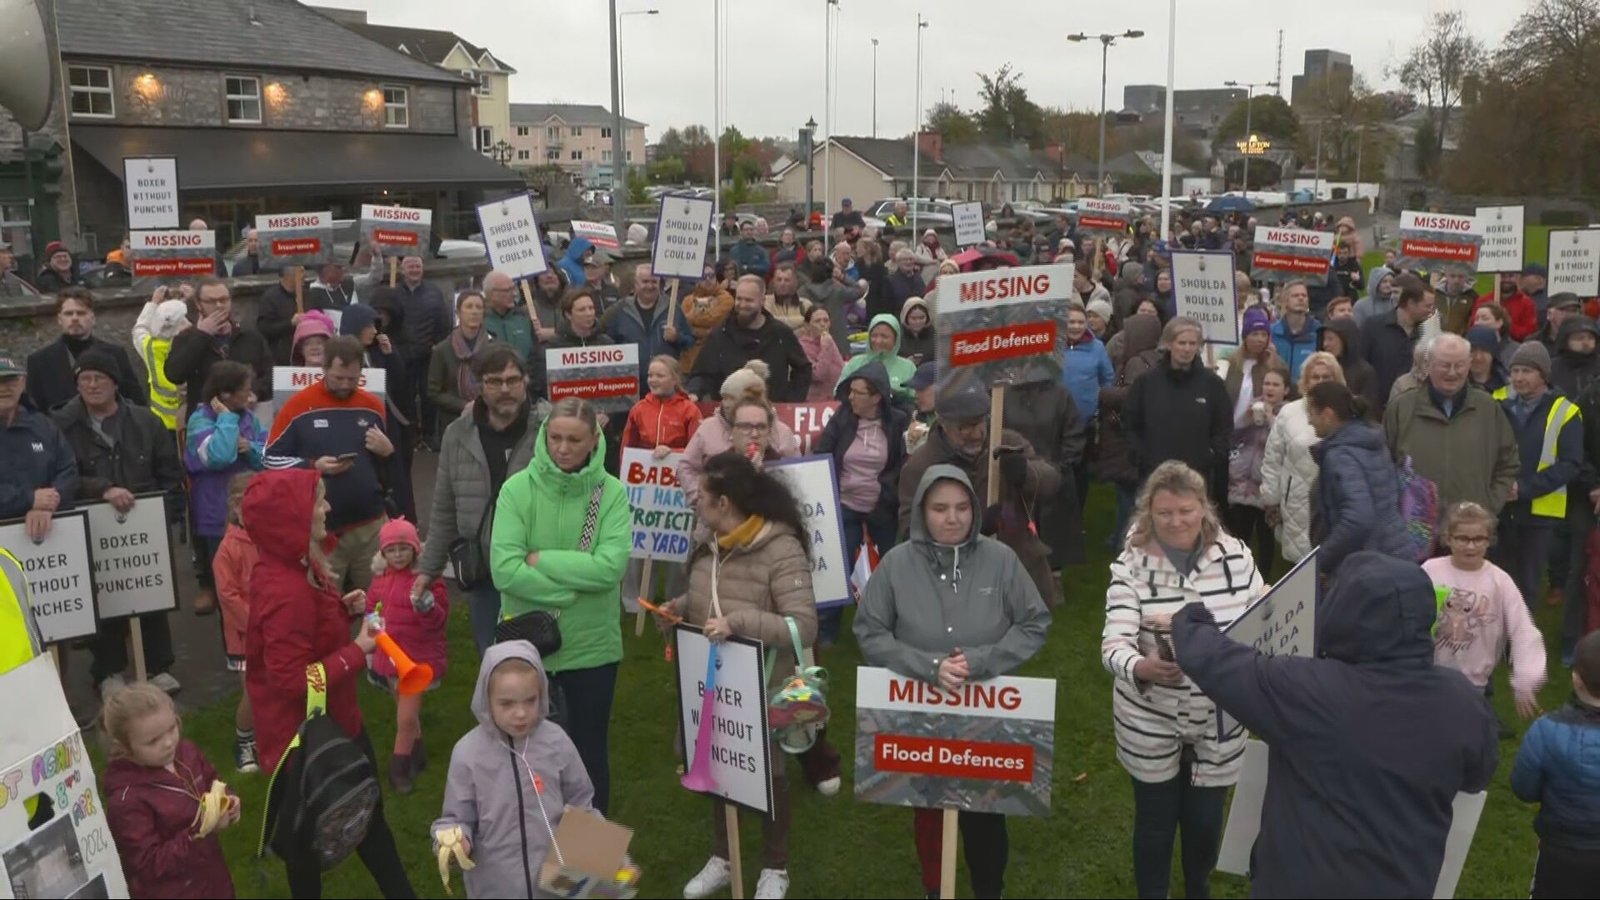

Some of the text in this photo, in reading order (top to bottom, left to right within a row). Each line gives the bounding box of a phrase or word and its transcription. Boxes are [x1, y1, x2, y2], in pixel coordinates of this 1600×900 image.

[137, 179, 166, 187] BOXER
[133, 192, 172, 200] WITHOUT
[134, 205, 173, 214] PUNCHES
[373, 209, 420, 221] MISSING
[268, 216, 320, 229] MISSING
[489, 219, 530, 236] SHOULDA
[665, 219, 704, 232] SHOULDA
[1414, 216, 1471, 231] MISSING
[1486, 225, 1513, 233] BOXER
[145, 235, 202, 247] MISSING
[378, 233, 412, 242] Insurance
[496, 234, 530, 249] WOULDA
[666, 235, 698, 246] WOULDA
[1267, 231, 1321, 246] MISSING
[277, 242, 315, 251] Insurance
[1406, 244, 1472, 256] Humanitarian Aid
[1561, 249, 1589, 257] BOXER
[500, 249, 534, 264] COULDA
[664, 249, 697, 260] COULDA
[1480, 250, 1518, 258] PUNCHES
[136, 261, 212, 271] Emergency Response
[1255, 255, 1326, 269] Emergency Response
[1554, 262, 1594, 271] WITHOUT
[1181, 278, 1226, 290] SHOULDA
[1554, 275, 1593, 283] PUNCHES
[960, 274, 1050, 304] MISSING
[1185, 295, 1224, 306] WOULDA
[1186, 311, 1225, 323] COULDA
[955, 331, 1050, 356] Flood Defences
[562, 350, 624, 366] MISSING
[552, 381, 635, 395] Emergency Response
[654, 486, 690, 508] HAR
[100, 532, 149, 550] BOXER
[651, 532, 689, 555] YARD
[94, 552, 160, 572] WITHOUT
[29, 575, 80, 595] THOUT
[97, 574, 164, 594] PUNCHES
[31, 598, 84, 617] NCHES
[698, 680, 743, 709] BXER
[889, 678, 1022, 711] MISSING
[691, 709, 753, 742] WTHOUT
[31, 731, 82, 787] AGAIN
[695, 740, 757, 774] NCHES
[882, 743, 1025, 770] Flood Defences
[72, 787, 97, 828] APR
